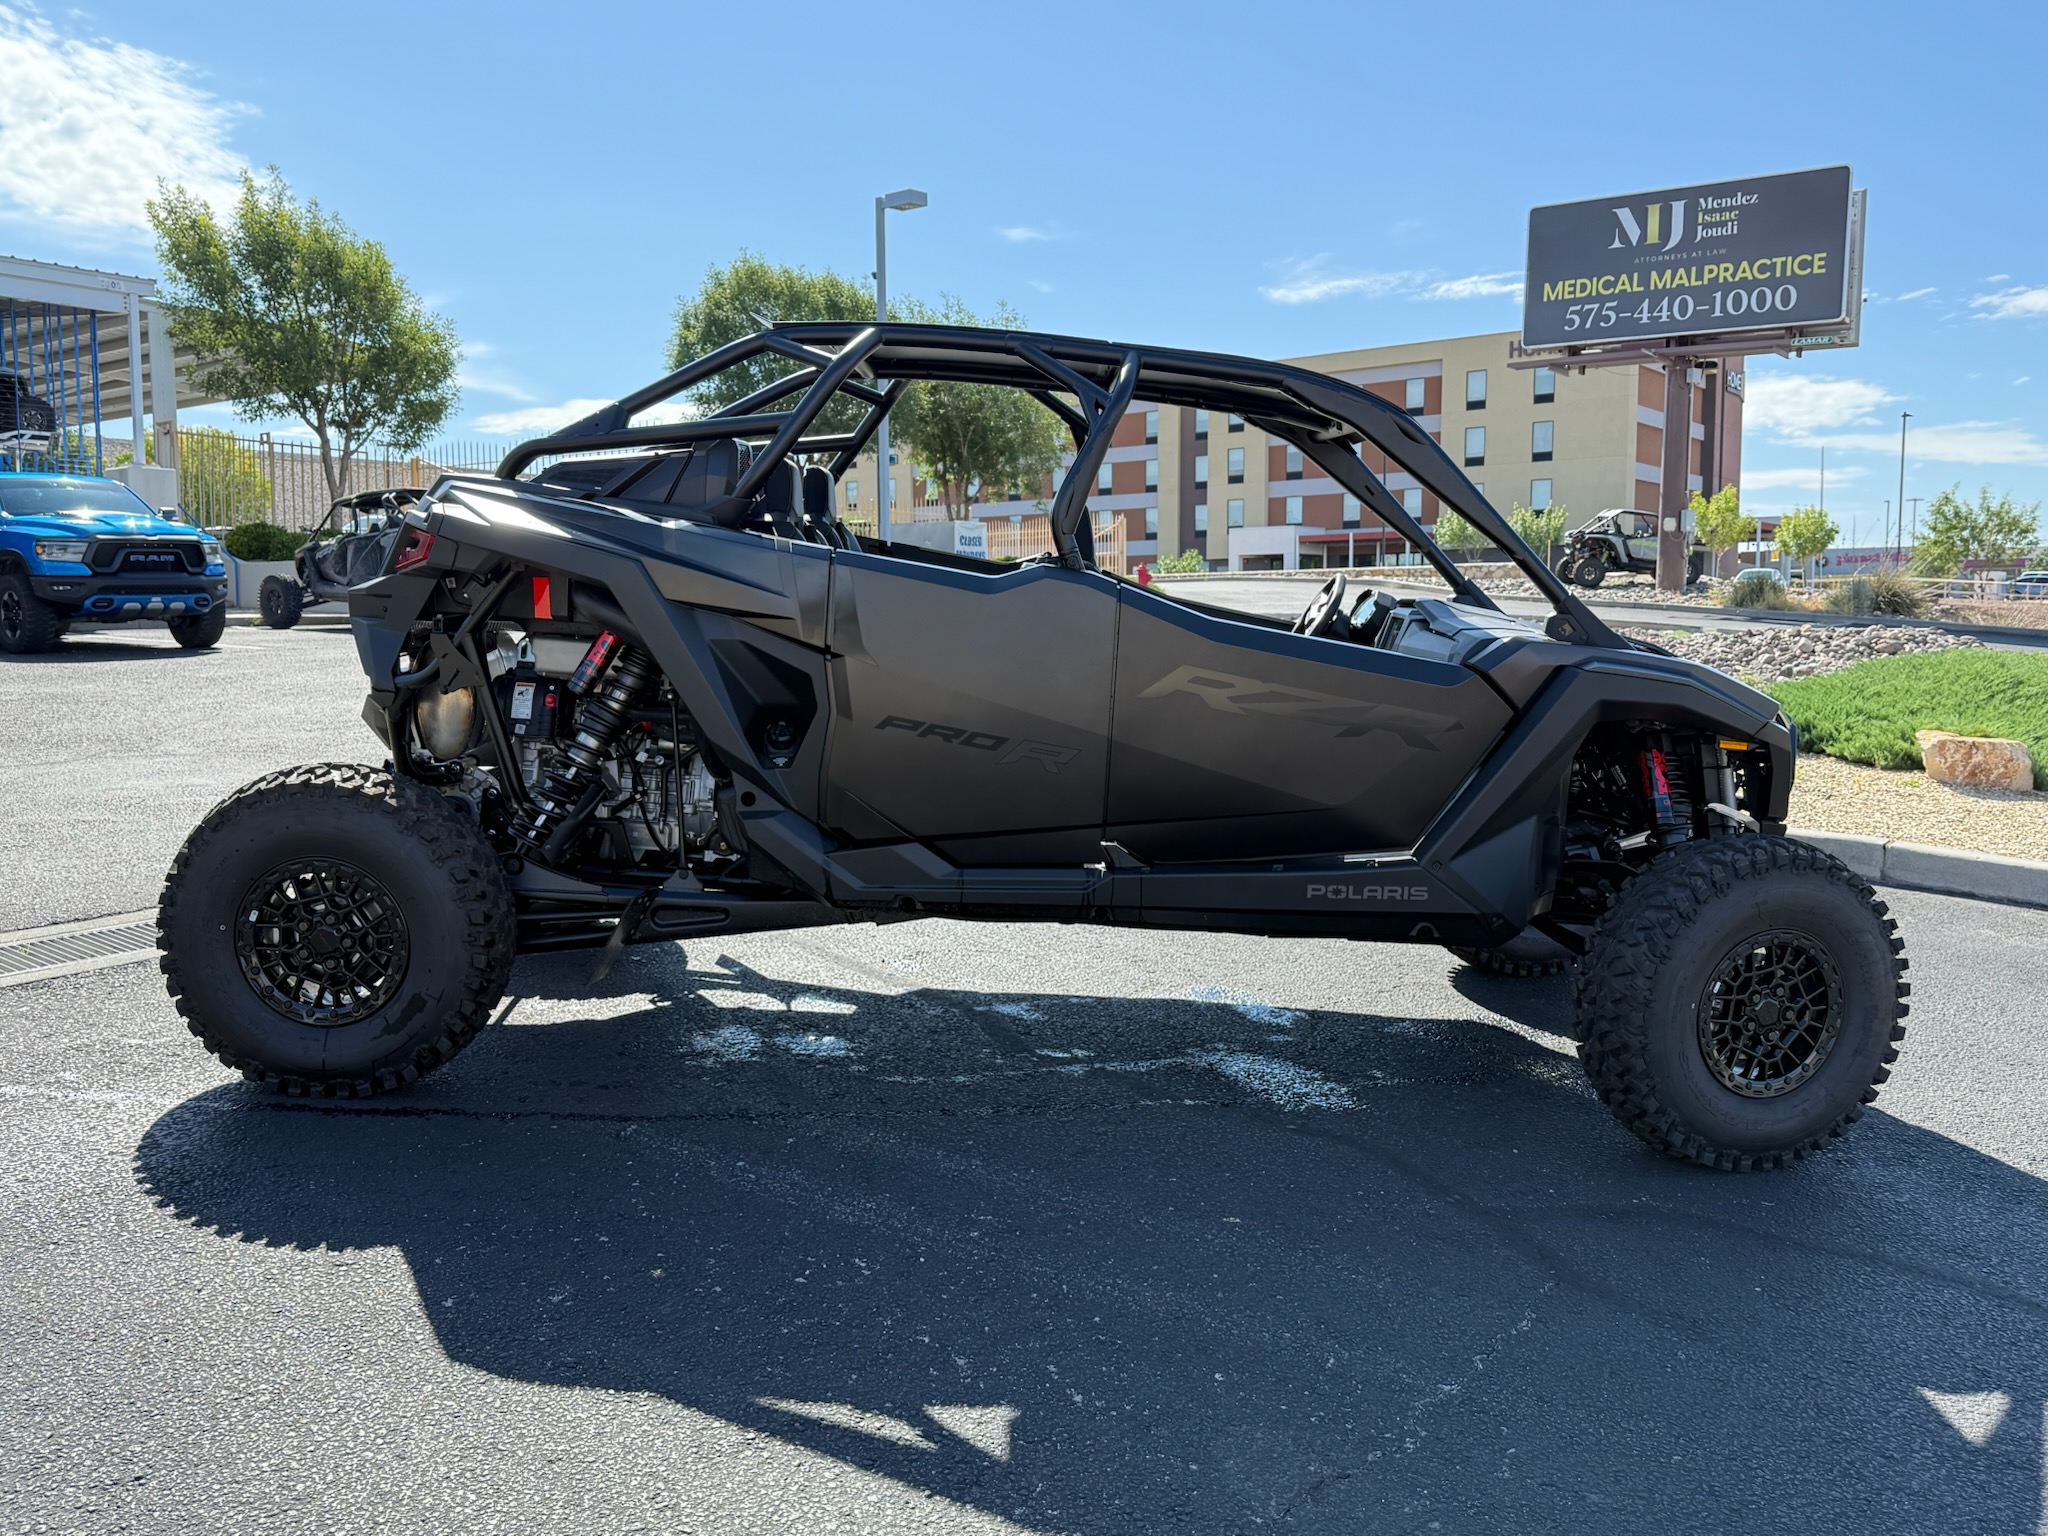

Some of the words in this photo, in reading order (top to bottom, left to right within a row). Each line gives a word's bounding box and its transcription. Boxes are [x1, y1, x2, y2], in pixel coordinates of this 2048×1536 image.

[1698, 191, 1759, 210] Mendez
[1608, 199, 1688, 252] MIJ
[1697, 209, 1740, 224] Isaac
[1694, 221, 1738, 243] Joudi
[1634, 251, 1688, 264] ATTORNEYS
[1691, 250, 1703, 258] AT
[1707, 247, 1727, 257] LAW
[1543, 272, 1644, 302] MEDICAL
[1650, 252, 1828, 291] MALPRACTICE
[1563, 284, 1798, 331] 575-440-1000
[1794, 336, 1831, 345] LAMAR
[130, 554, 176, 562] RAM
[874, 715, 1010, 751] PRO
[994, 739, 1083, 775] R
[1306, 884, 1430, 901] POLARIS
